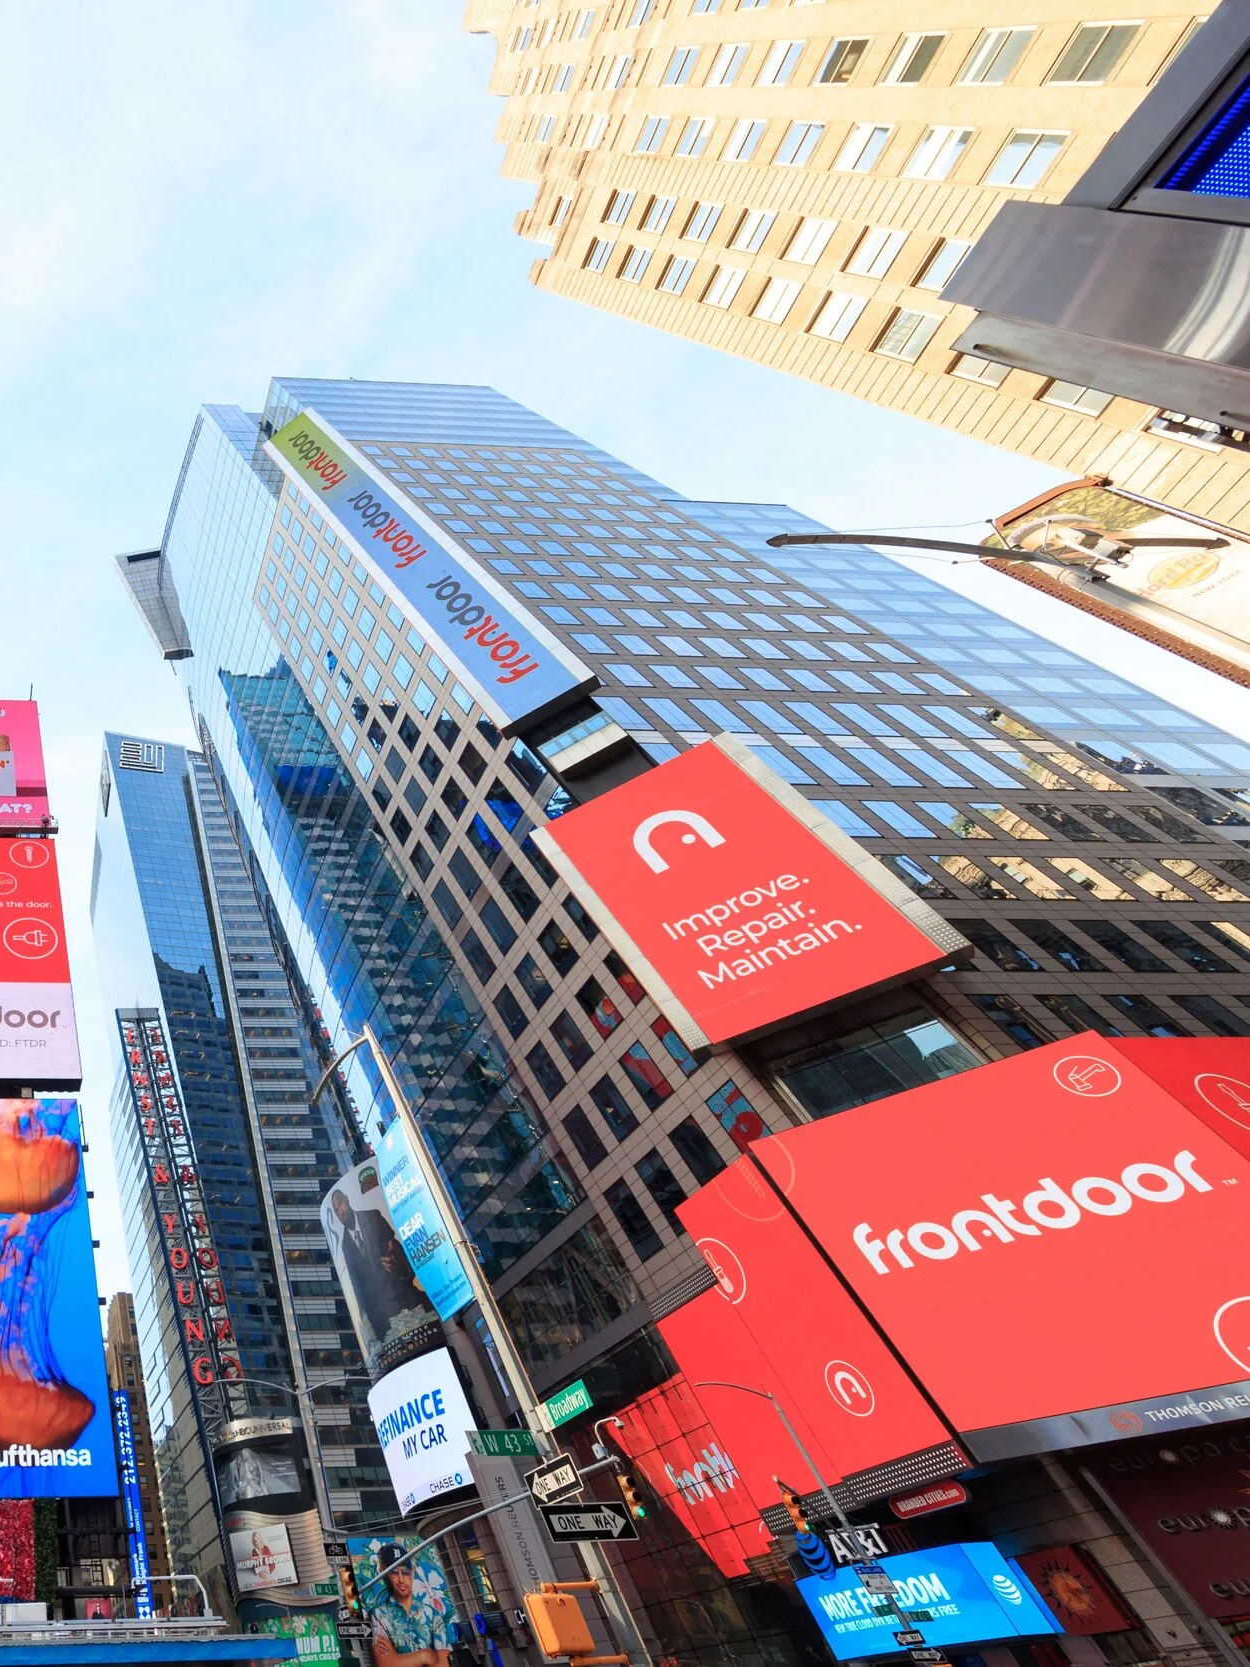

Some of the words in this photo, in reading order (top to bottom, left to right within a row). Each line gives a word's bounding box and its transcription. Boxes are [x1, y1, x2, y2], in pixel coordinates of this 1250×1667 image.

[292, 429, 349, 493] frontdoor
[349, 489, 427, 571] frontdoor
[429, 574, 541, 685] frontdoor
[6, 900, 24, 908] the
[26, 900, 53, 909] door.
[662, 872, 810, 941] Improve.
[695, 903, 817, 959] Repair.
[697, 920, 863, 991] Maintain.
[14, 1038, 47, 1048] FTDR
[382, 1155, 410, 1187] WINNER
[399, 1212, 425, 1240] DEAR
[852, 1149, 1214, 1275] frontdoor
[404, 1225, 429, 1252] EVAN
[410, 1228, 447, 1266] HANSEN
[163, 1214, 213, 1385] YOUNG
[550, 1387, 590, 1422] Broadway
[1145, 1399, 1225, 1422] THOMSON
[402, 1433, 417, 1460] MY
[420, 1423, 448, 1450] CAR
[483, 1436, 500, 1452] W
[504, 1435, 522, 1453] 43
[430, 1476, 454, 1494] CHASE
[535, 1480, 551, 1496] ONE
[553, 1468, 572, 1487] WAY
[896, 1495, 927, 1512] BRANDED
[557, 1516, 586, 1531] ONE
[593, 1515, 620, 1529] WAY
[236, 1557, 263, 1570] MURPHY
[516, 1531, 542, 1592] HOMSON
[819, 1590, 864, 1621] MORE
[939, 1604, 960, 1616] FREE
[340, 1626, 351, 1635] ONE
